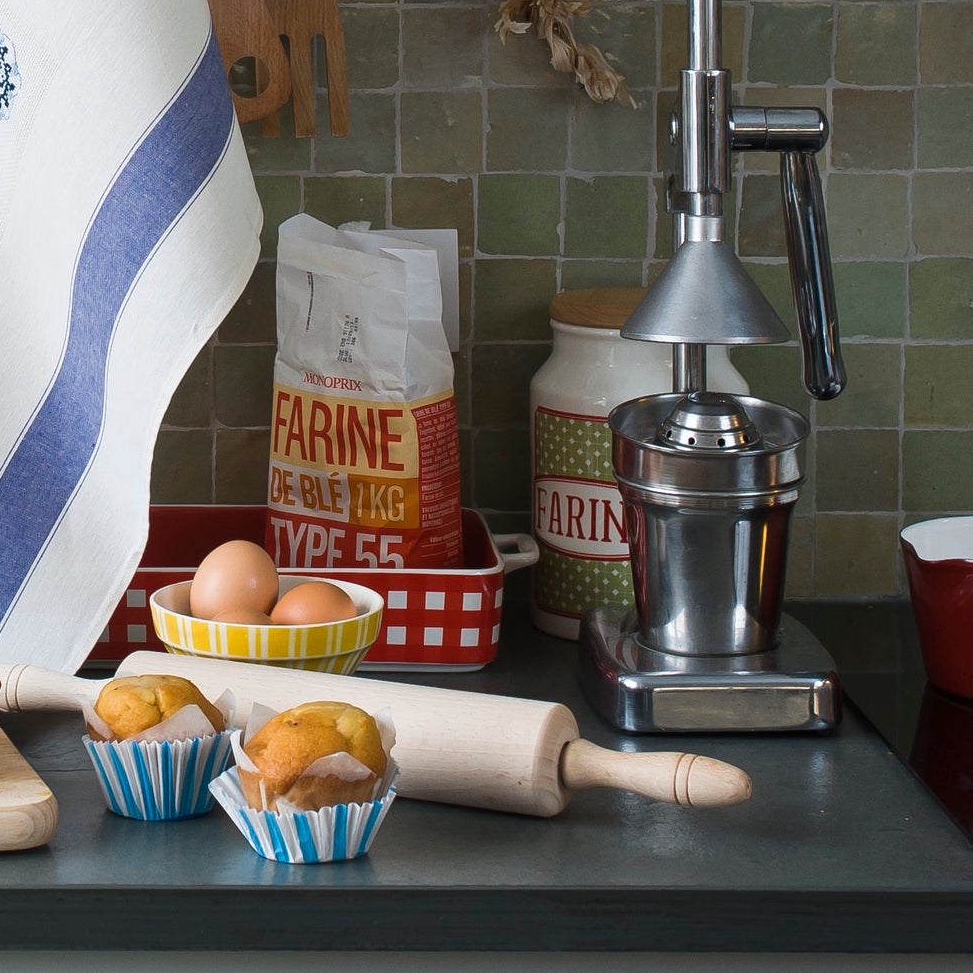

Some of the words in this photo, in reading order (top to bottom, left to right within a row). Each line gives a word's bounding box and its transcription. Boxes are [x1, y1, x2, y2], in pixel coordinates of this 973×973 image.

[303, 372, 363, 392] MONOPRIX
[273, 391, 405, 471] FARINE
[270, 468, 296, 506] DE
[299, 471, 344, 514] BLÉ
[536, 487, 629, 544] FARIN
[271, 516, 346, 568] TYPE
[355, 532, 405, 569] 55
